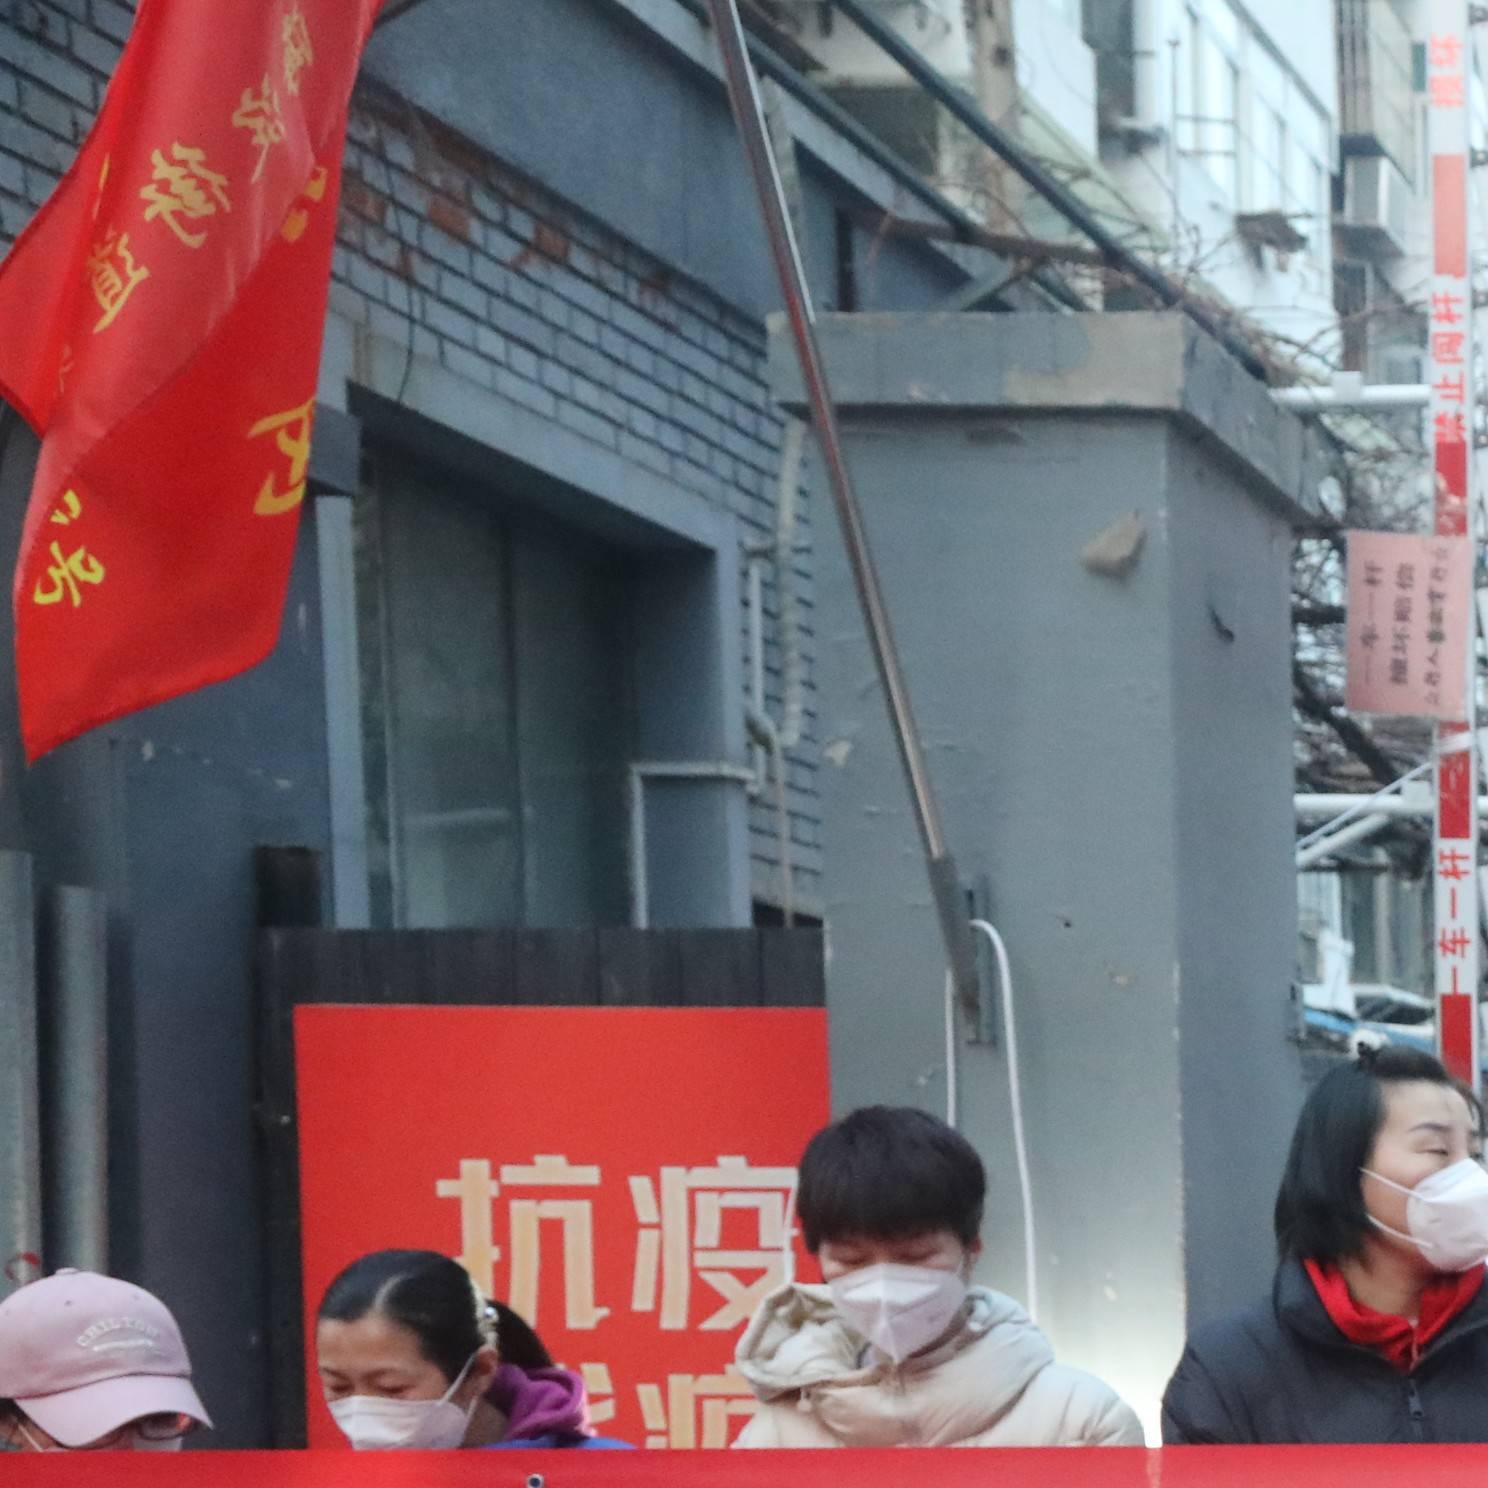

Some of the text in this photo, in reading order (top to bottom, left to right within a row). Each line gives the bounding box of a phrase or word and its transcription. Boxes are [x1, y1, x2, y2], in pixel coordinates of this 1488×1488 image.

[1437, 848, 1471, 995] 一车一杆
[435, 1153, 800, 1332] 抗疫
